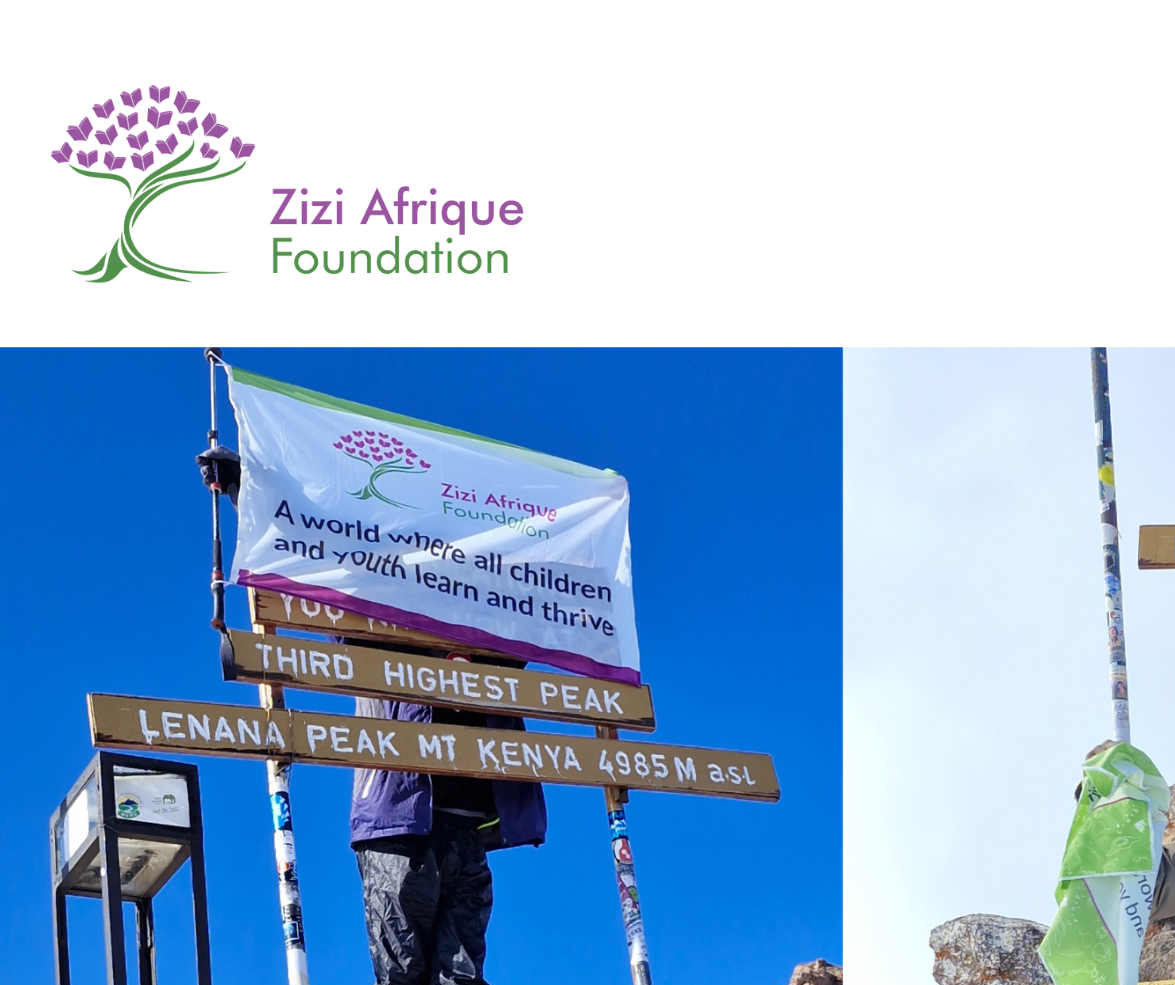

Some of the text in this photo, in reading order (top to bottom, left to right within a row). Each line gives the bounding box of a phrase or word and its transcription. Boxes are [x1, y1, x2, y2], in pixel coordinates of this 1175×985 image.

[440, 482, 558, 522] Zizi Afrique
[442, 500, 550, 540] Foundation
[273, 499, 612, 603] A world where all children
[273, 535, 325, 562] and
[332, 548, 407, 580] youth
[415, 563, 479, 602] learn
[486, 588, 535, 617] and
[540, 602, 616, 637] thrive
[255, 642, 624, 715] THIRD HIGHEST PEAK
[138, 709, 284, 746] LENANA
[306, 725, 400, 758] PEAK
[419, 736, 456, 763] MT
[476, 738, 582, 778] KENYA
[598, 750, 669, 782] 4985
